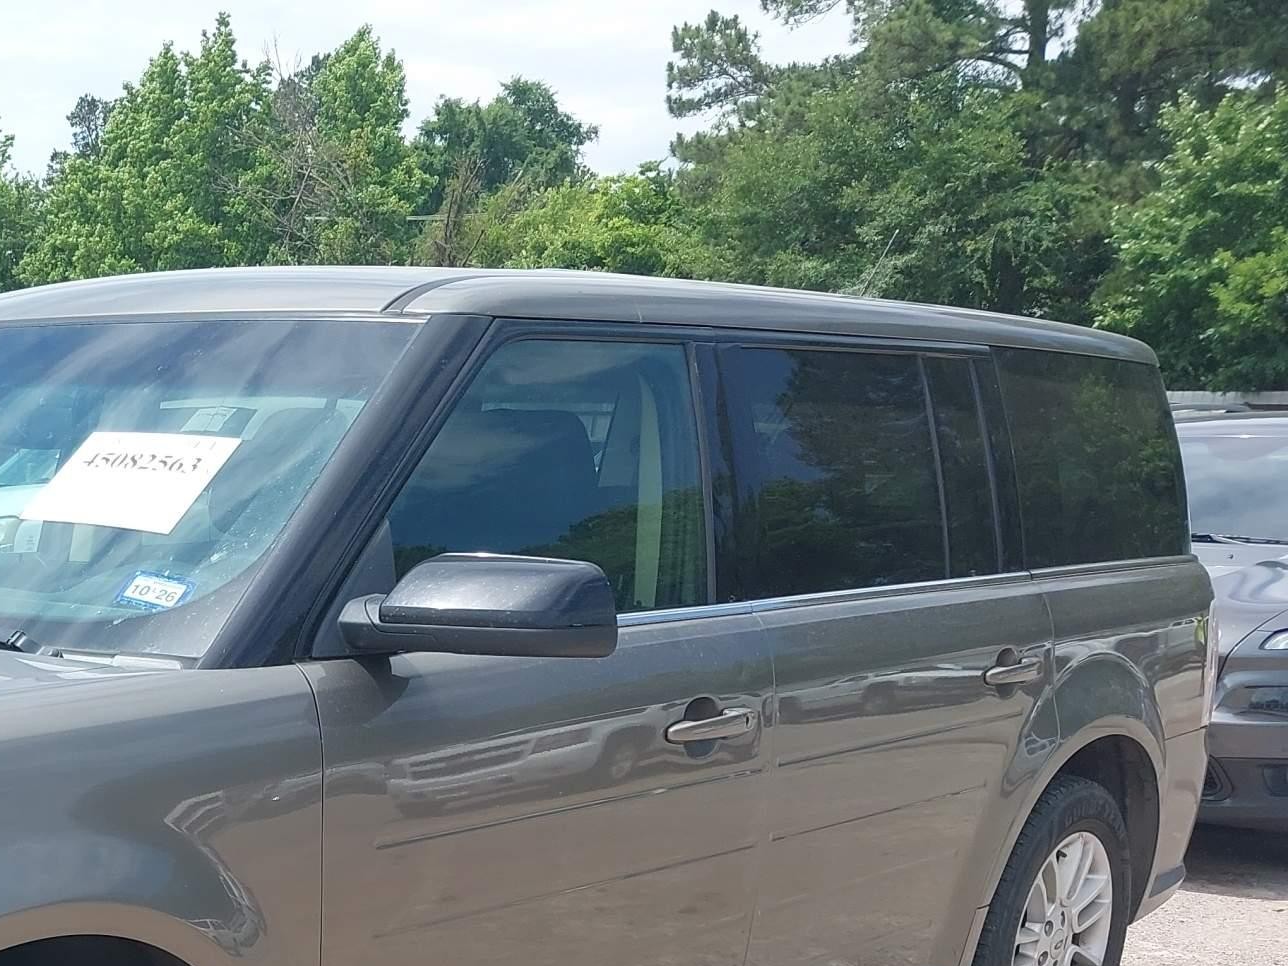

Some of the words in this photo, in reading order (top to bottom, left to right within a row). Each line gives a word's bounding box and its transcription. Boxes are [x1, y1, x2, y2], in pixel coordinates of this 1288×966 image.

[83, 452, 203, 474] 45082563
[131, 583, 151, 596] 10
[155, 588, 178, 603] 26
